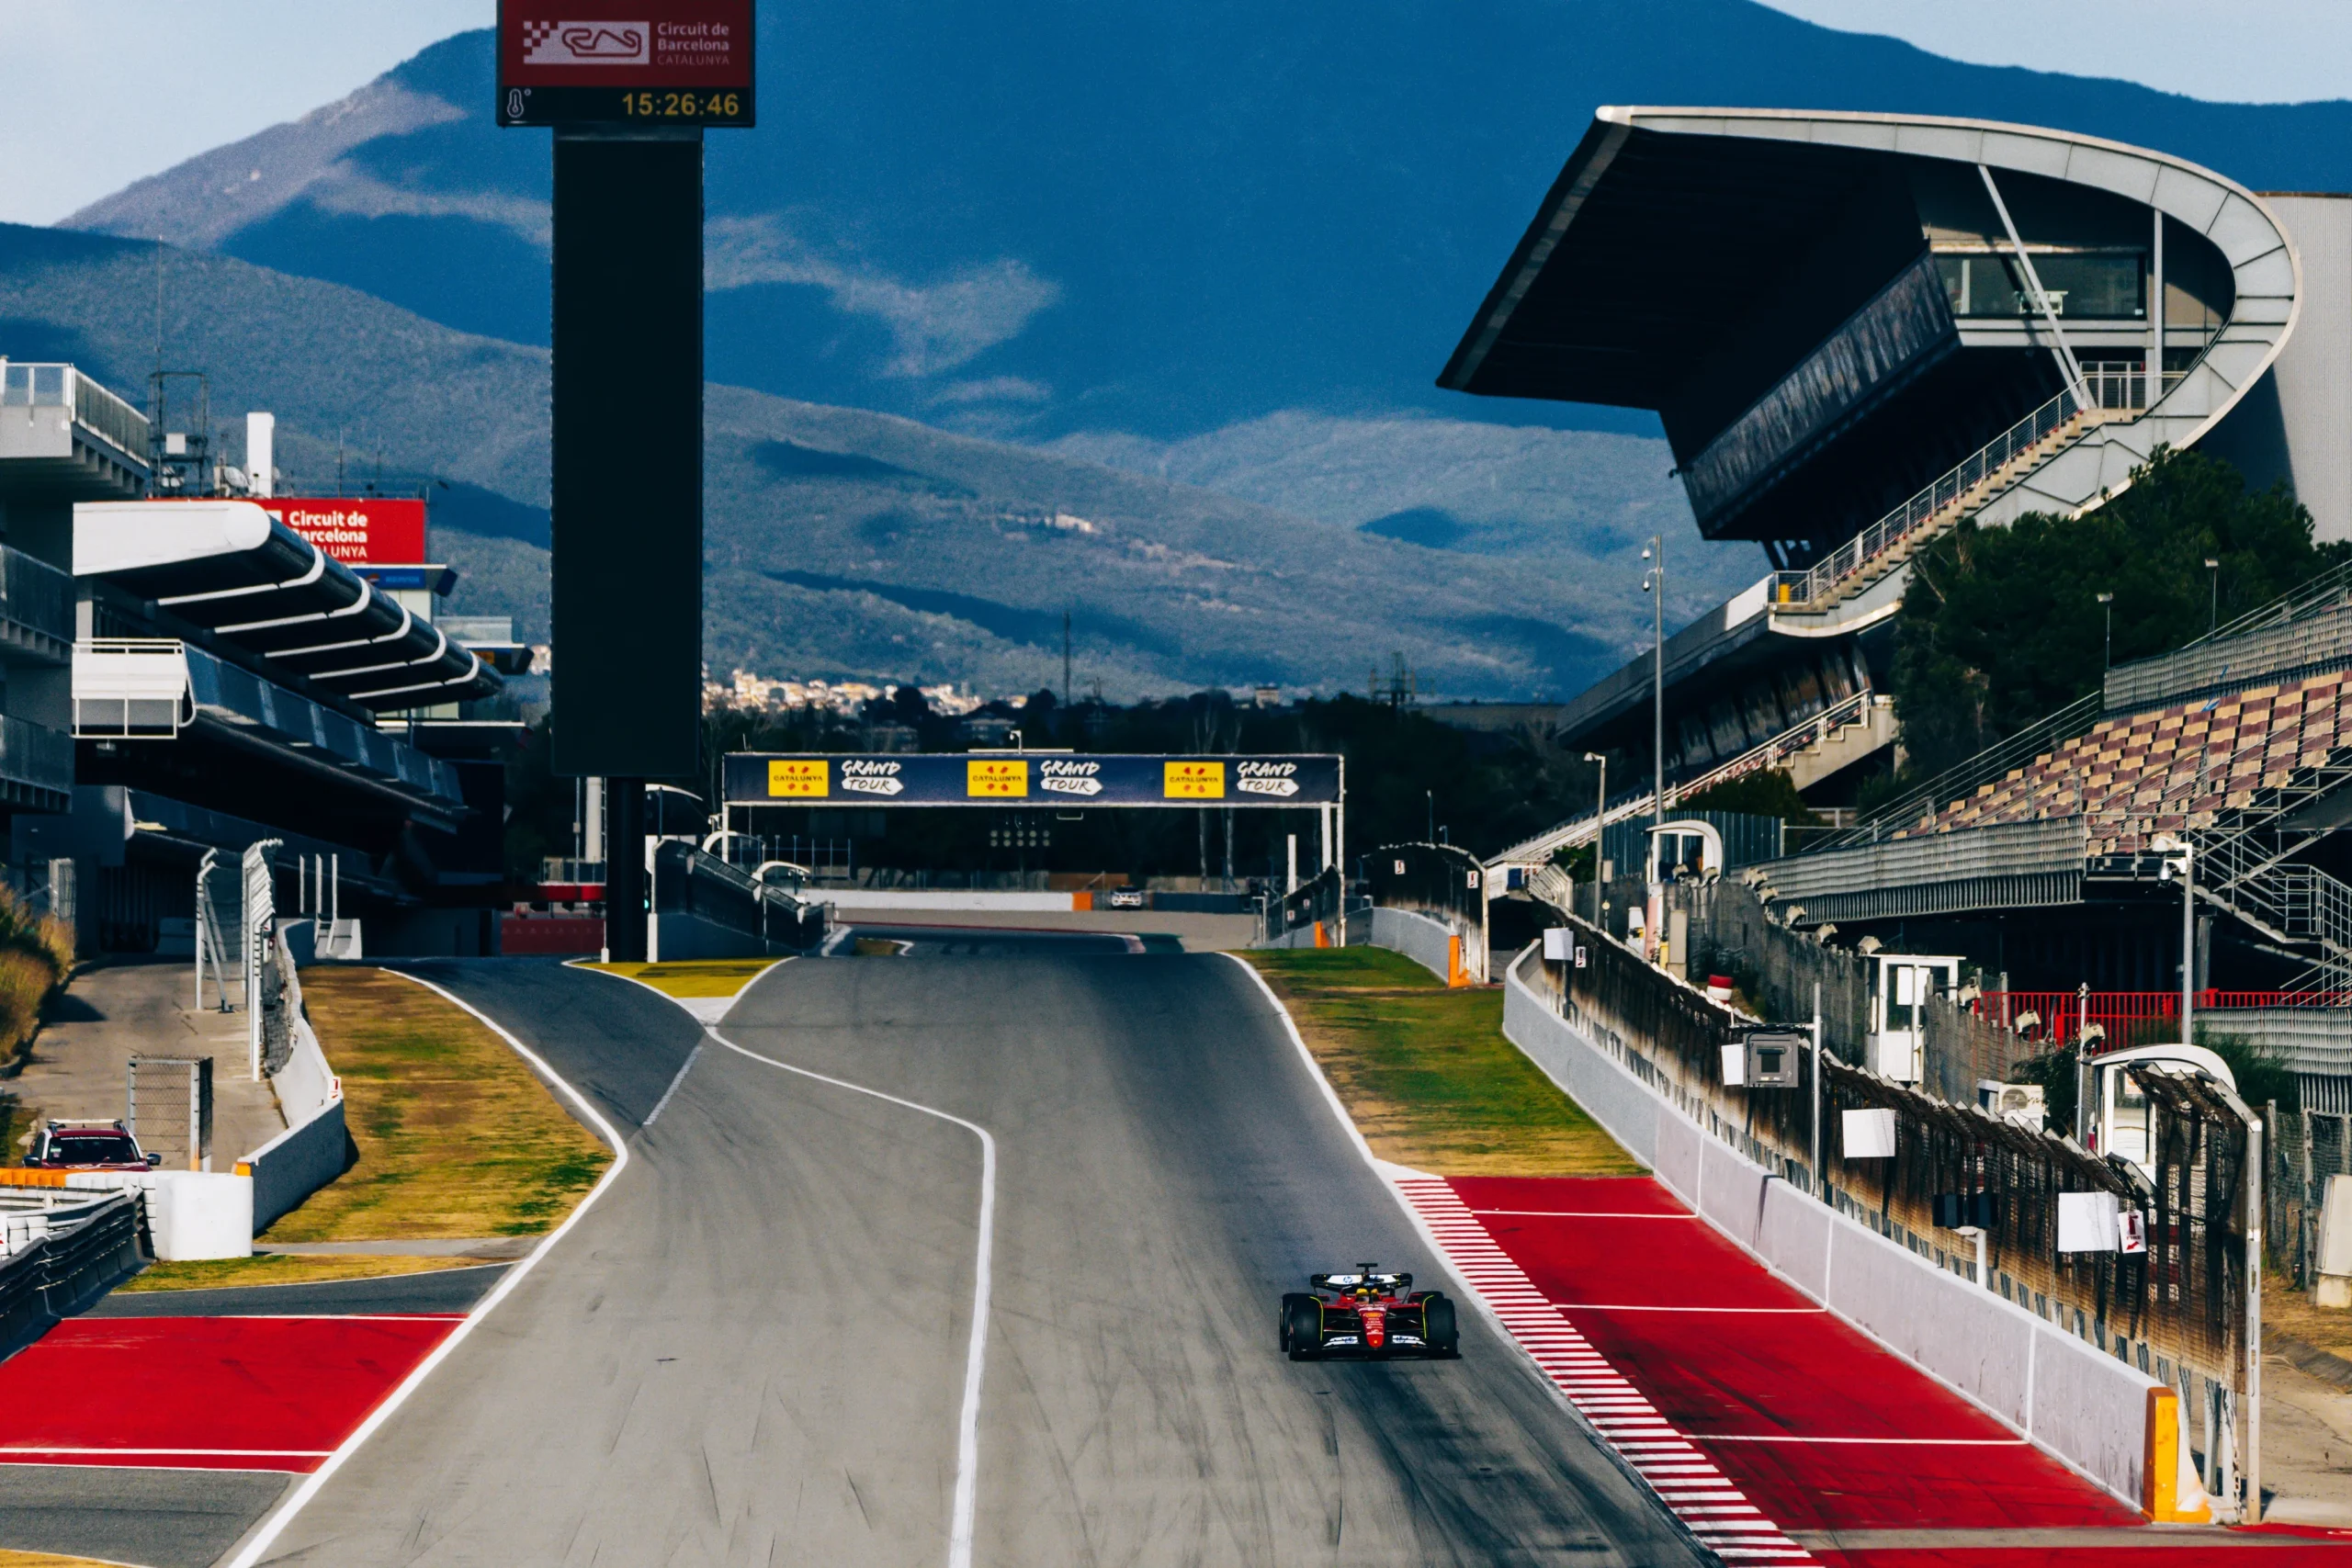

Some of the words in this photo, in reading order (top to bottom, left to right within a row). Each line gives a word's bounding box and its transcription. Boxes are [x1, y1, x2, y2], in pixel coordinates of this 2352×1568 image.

[658, 21, 708, 36] Circuit
[711, 22, 729, 36] de
[658, 38, 729, 51] Barcelona
[657, 55, 729, 65] CATALUNYA
[622, 93, 739, 116] 15:26:46
[289, 511, 345, 526] Circuit
[347, 511, 368, 526] de
[842, 760, 900, 776] GRAND
[1040, 760, 1101, 777] GRAND
[1237, 761, 1297, 778] GRAND
[850, 779, 891, 792] TOUR
[1048, 779, 1091, 792] TOUR
[1245, 780, 1288, 793] TOUR
